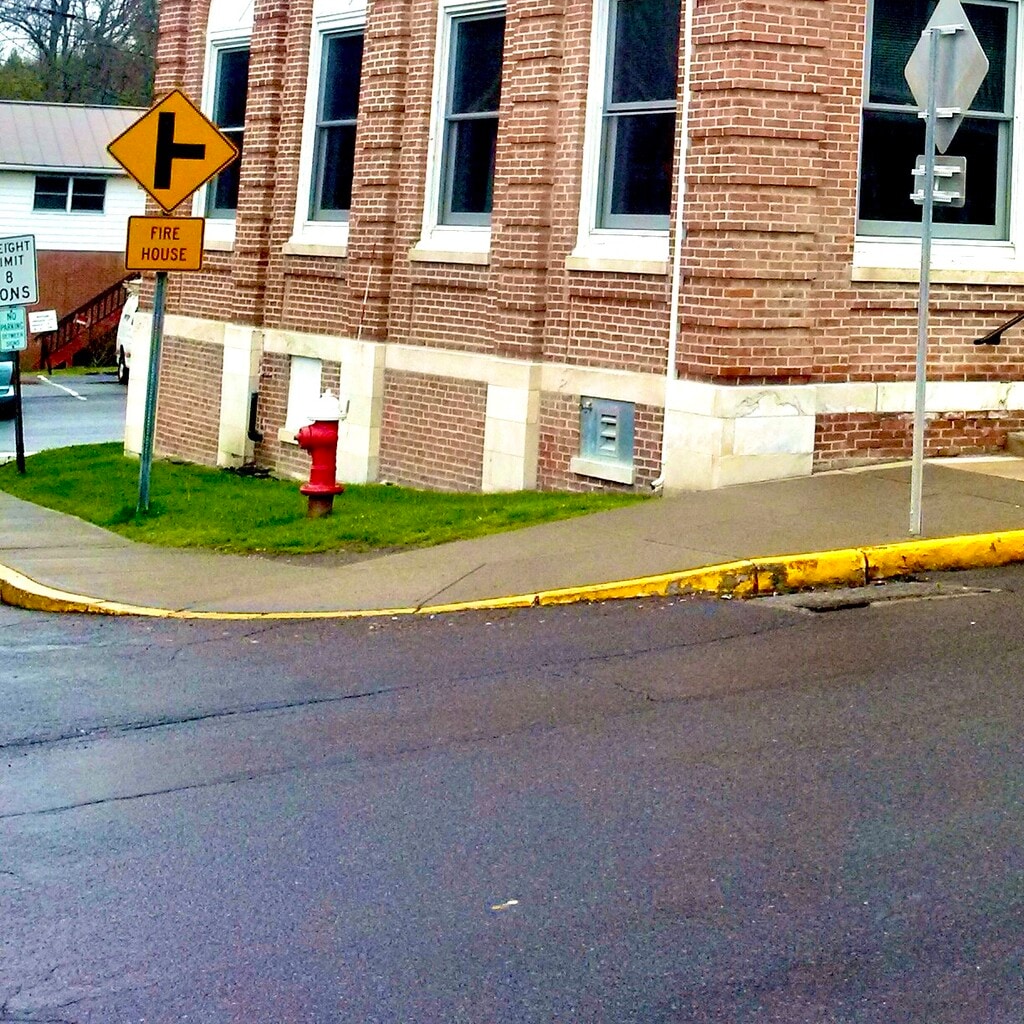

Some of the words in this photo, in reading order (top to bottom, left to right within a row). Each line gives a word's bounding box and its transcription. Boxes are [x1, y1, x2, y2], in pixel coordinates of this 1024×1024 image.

[150, 226, 180, 241] FIRE
[141, 247, 187, 262] HOUSE
[5, 270, 13, 284] 8
[0, 285, 30, 302] ONS
[6, 313, 17, 321] NO
